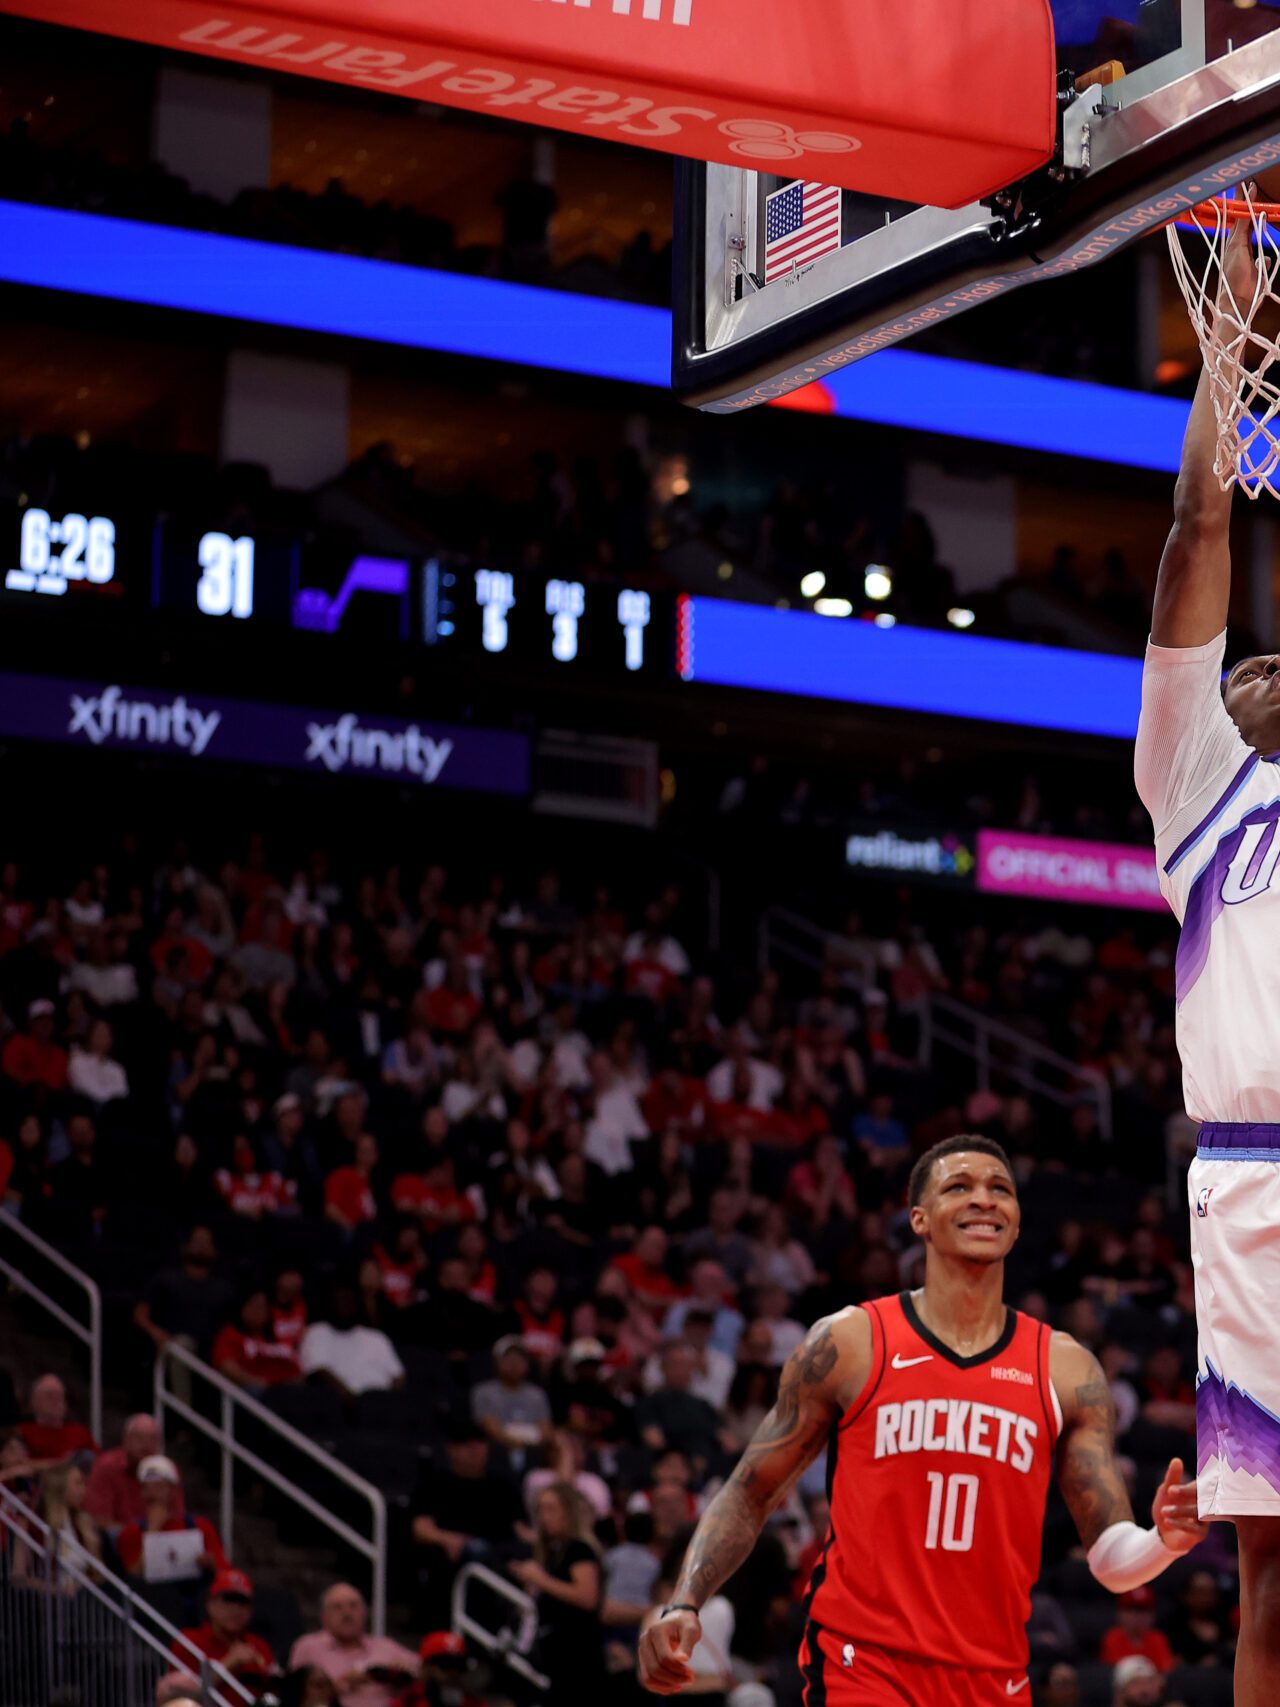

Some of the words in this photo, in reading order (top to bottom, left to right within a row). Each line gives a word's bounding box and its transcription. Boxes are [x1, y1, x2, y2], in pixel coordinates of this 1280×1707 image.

[816, 306, 949, 367] veraclinic.net
[955, 280, 1004, 304] Hair
[1105, 190, 1194, 235] Turkey
[20, 508, 116, 583] 6:26
[197, 531, 255, 619] 31
[69, 686, 220, 755] xfinity
[306, 714, 454, 783] xfinity
[847, 831, 941, 874] reliant
[874, 1399, 1038, 1474] ROCKETS
[925, 1471, 980, 1551] 10
